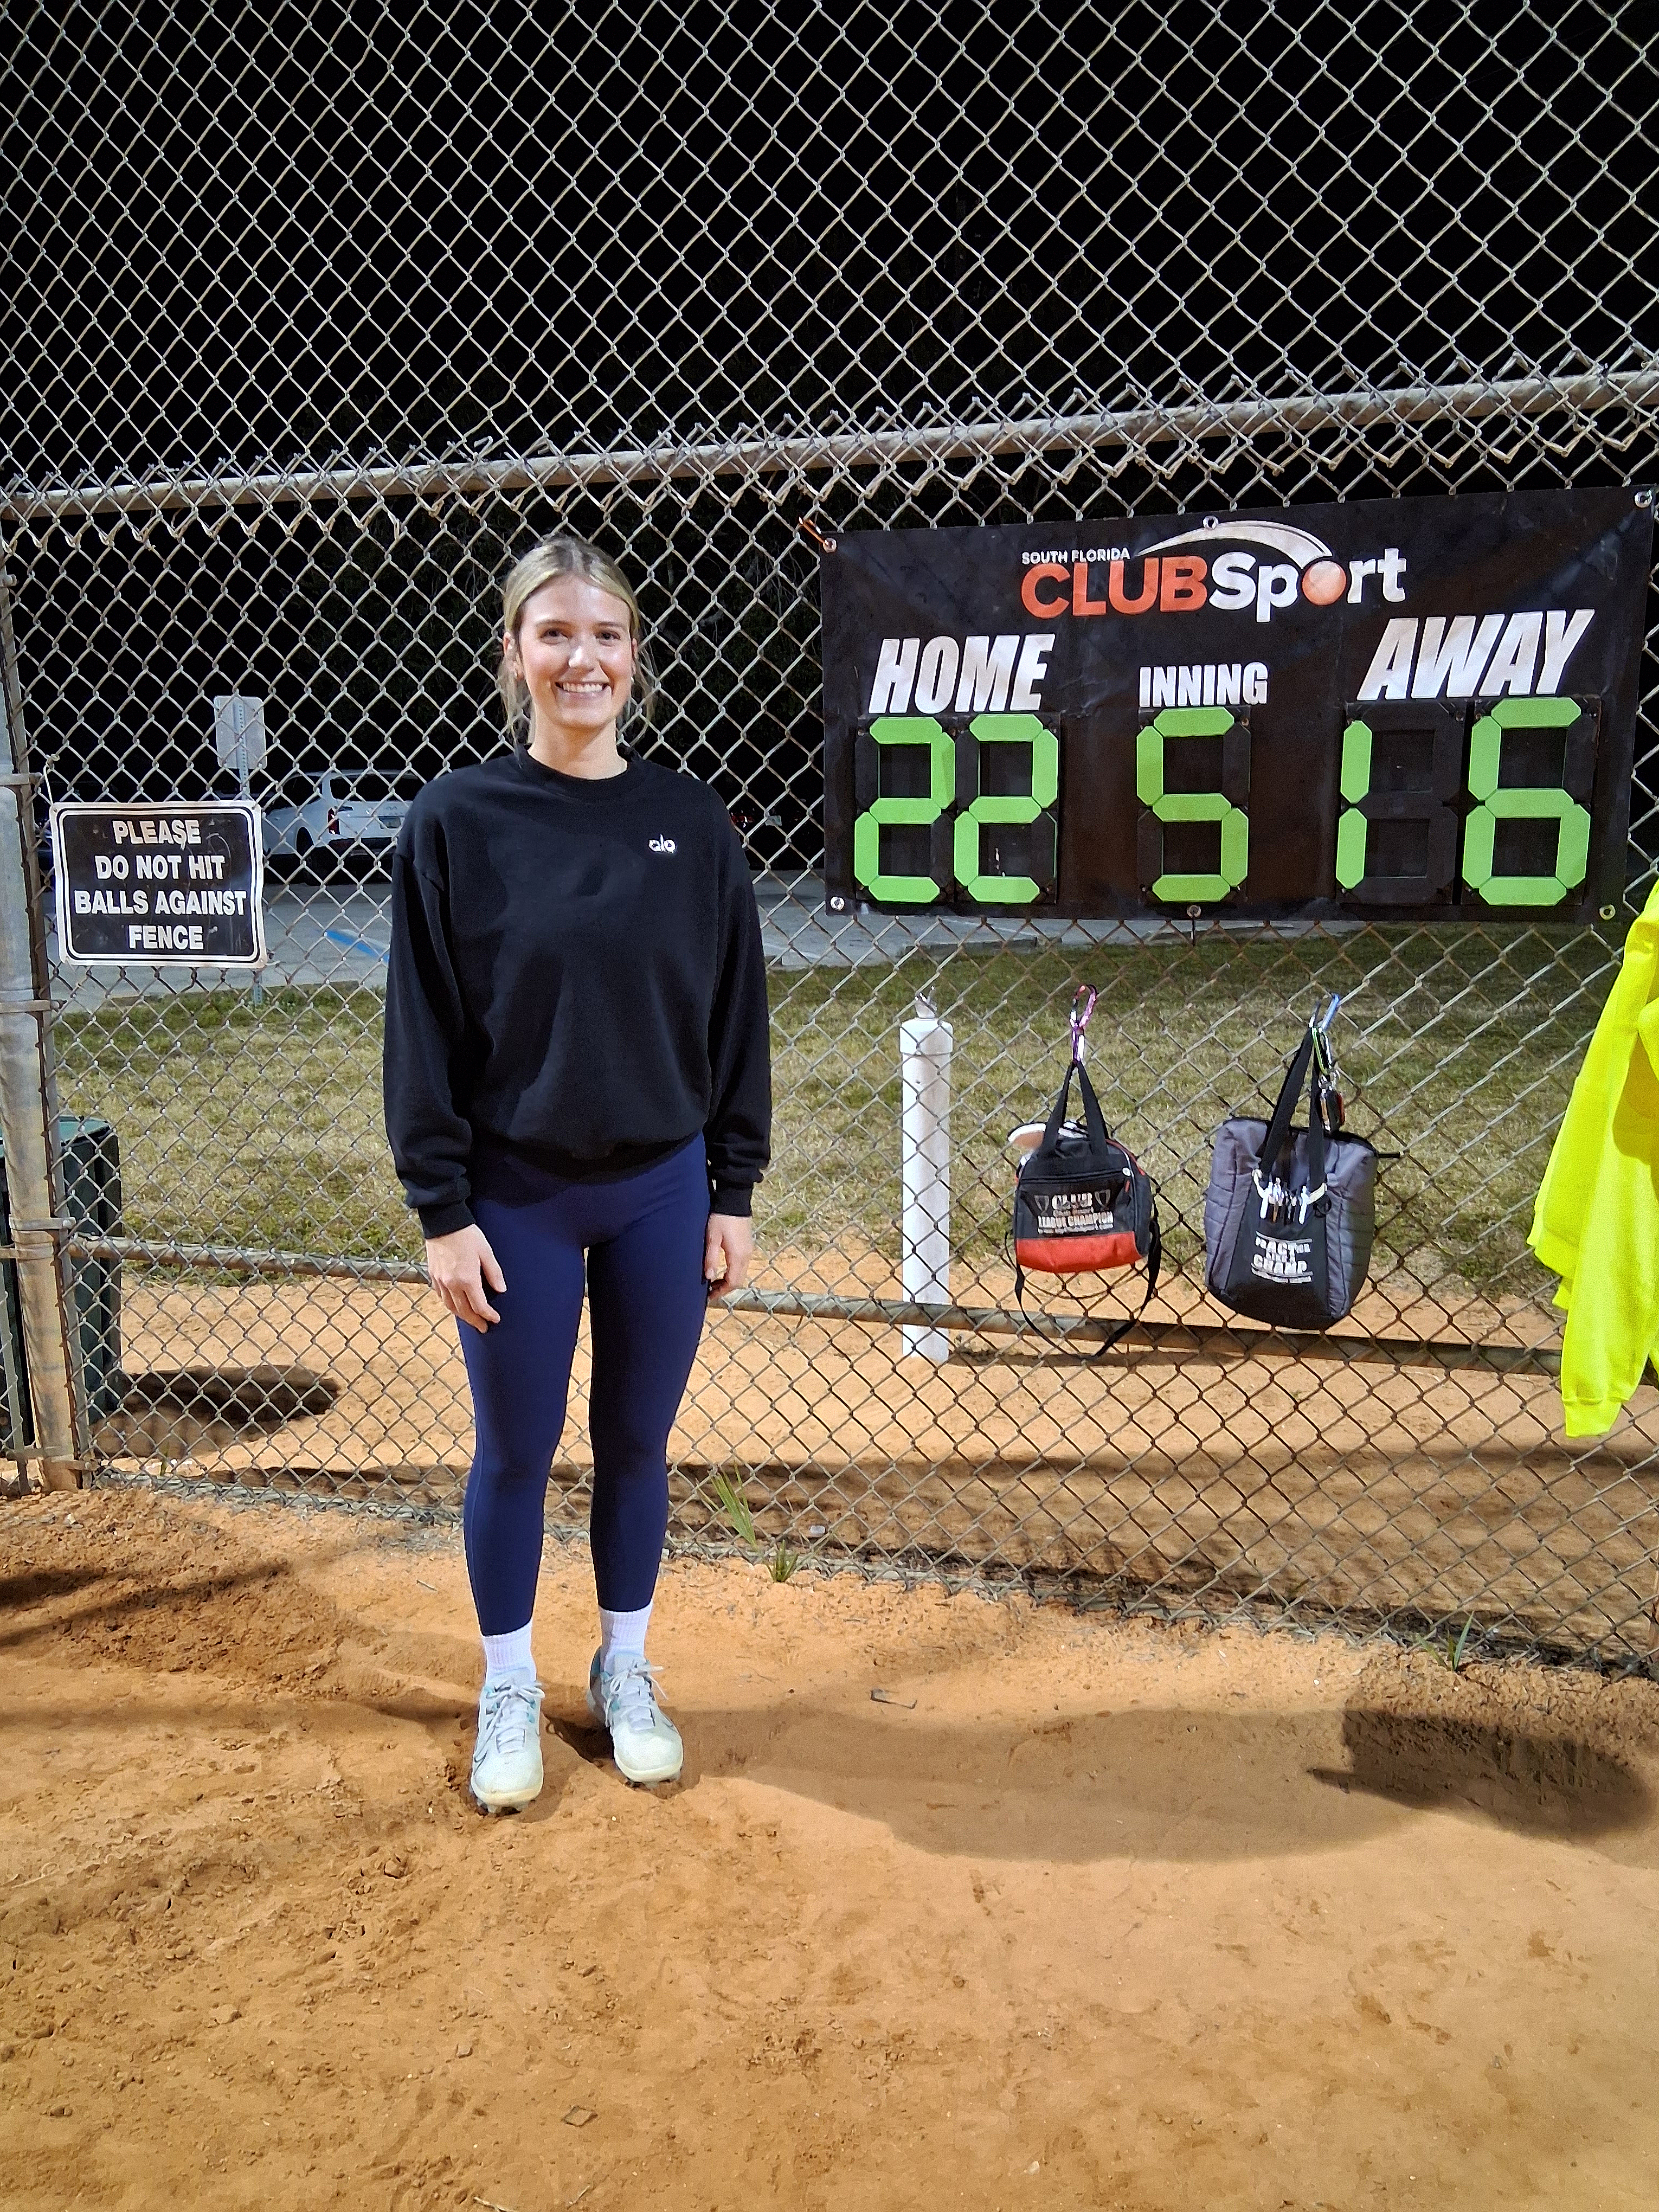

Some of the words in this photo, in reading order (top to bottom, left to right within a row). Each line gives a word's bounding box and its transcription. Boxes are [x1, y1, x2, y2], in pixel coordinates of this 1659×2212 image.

[1022, 550, 1068, 565] SOUTH
[1072, 547, 1130, 563] FLORIDA
[1356, 609, 1595, 700] AWAY
[869, 633, 1055, 714] HOME
[1139, 661, 1268, 708] INNING
[854, 713, 1059, 903] 22
[1136, 707, 1249, 903] 5
[1336, 697, 1591, 906] 16
[112, 820, 202, 845] PLEASE
[648, 833, 677, 853] alo
[95, 855, 130, 879] DO
[137, 856, 184, 879] NOT
[188, 855, 226, 879] HIT
[74, 890, 148, 915] BALLS
[155, 890, 247, 916] AGAINST
[128, 925, 204, 950] FENCE
